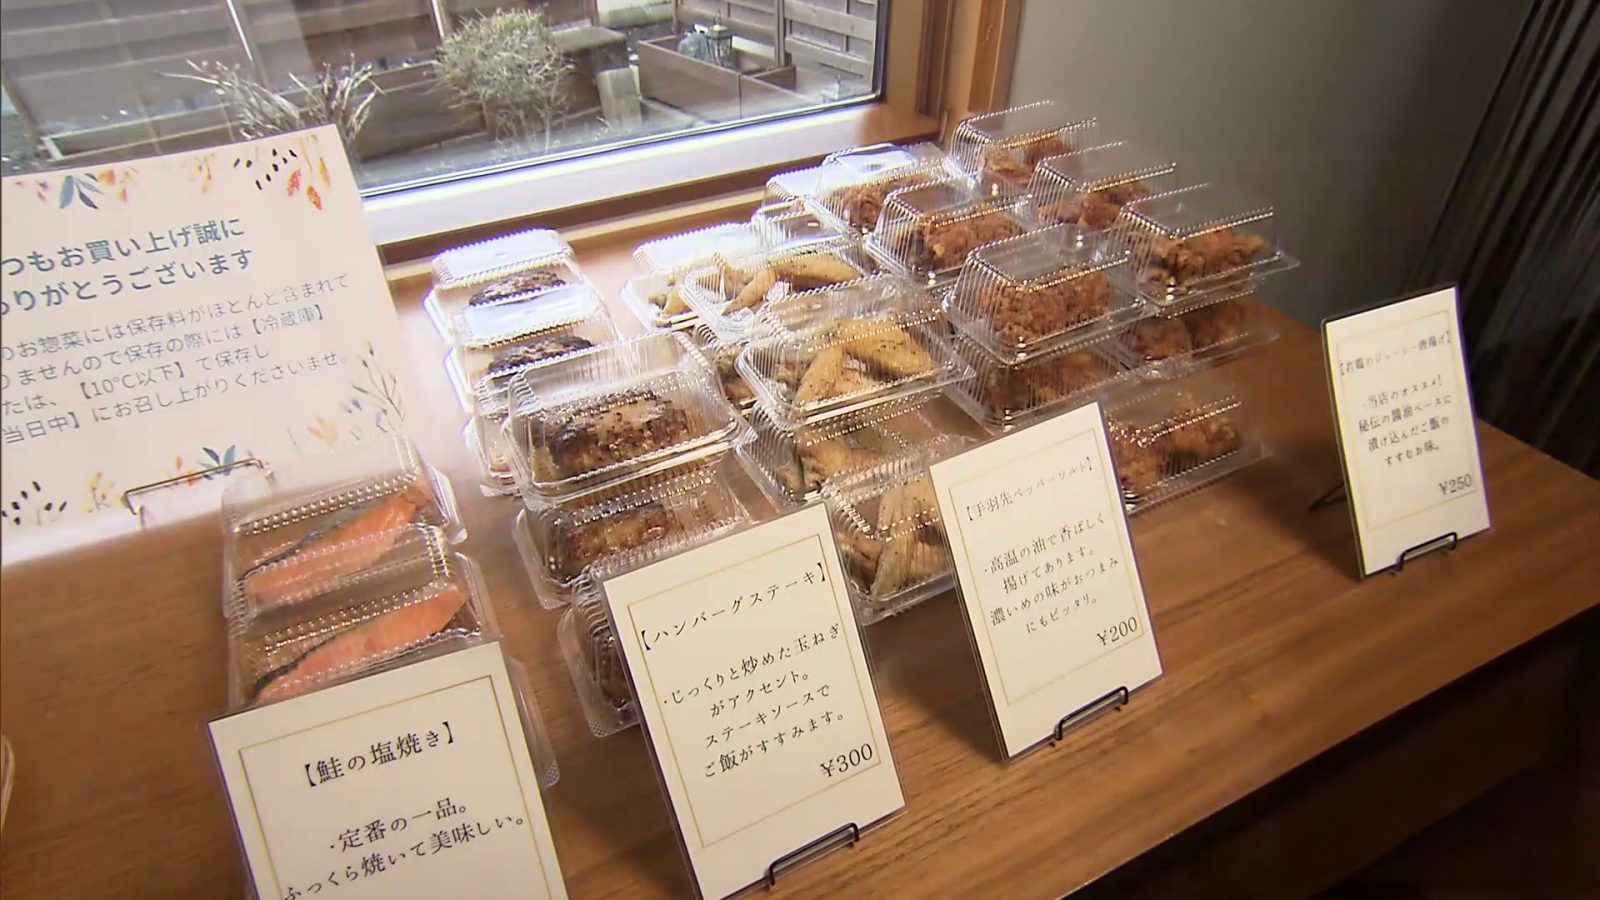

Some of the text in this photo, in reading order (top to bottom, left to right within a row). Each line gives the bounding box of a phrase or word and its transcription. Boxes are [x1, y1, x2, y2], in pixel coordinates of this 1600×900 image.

[1438, 473, 1473, 496] ¥250
[990, 557, 1119, 626] 濃いめの味がおつまみ
[1002, 546, 1095, 595] 揚げてあります。
[640, 562, 827, 650] 【ハンバーグステーキ】
[1096, 615, 1139, 647] ¥200
[706, 684, 830, 749] ステーキソースで
[709, 670, 809, 718] がアクセント。
[304, 720, 455, 788] 【鮭の塩焼き】
[704, 710, 844, 779] ご飯がすすみます。
[819, 742, 874, 779] ¥300
